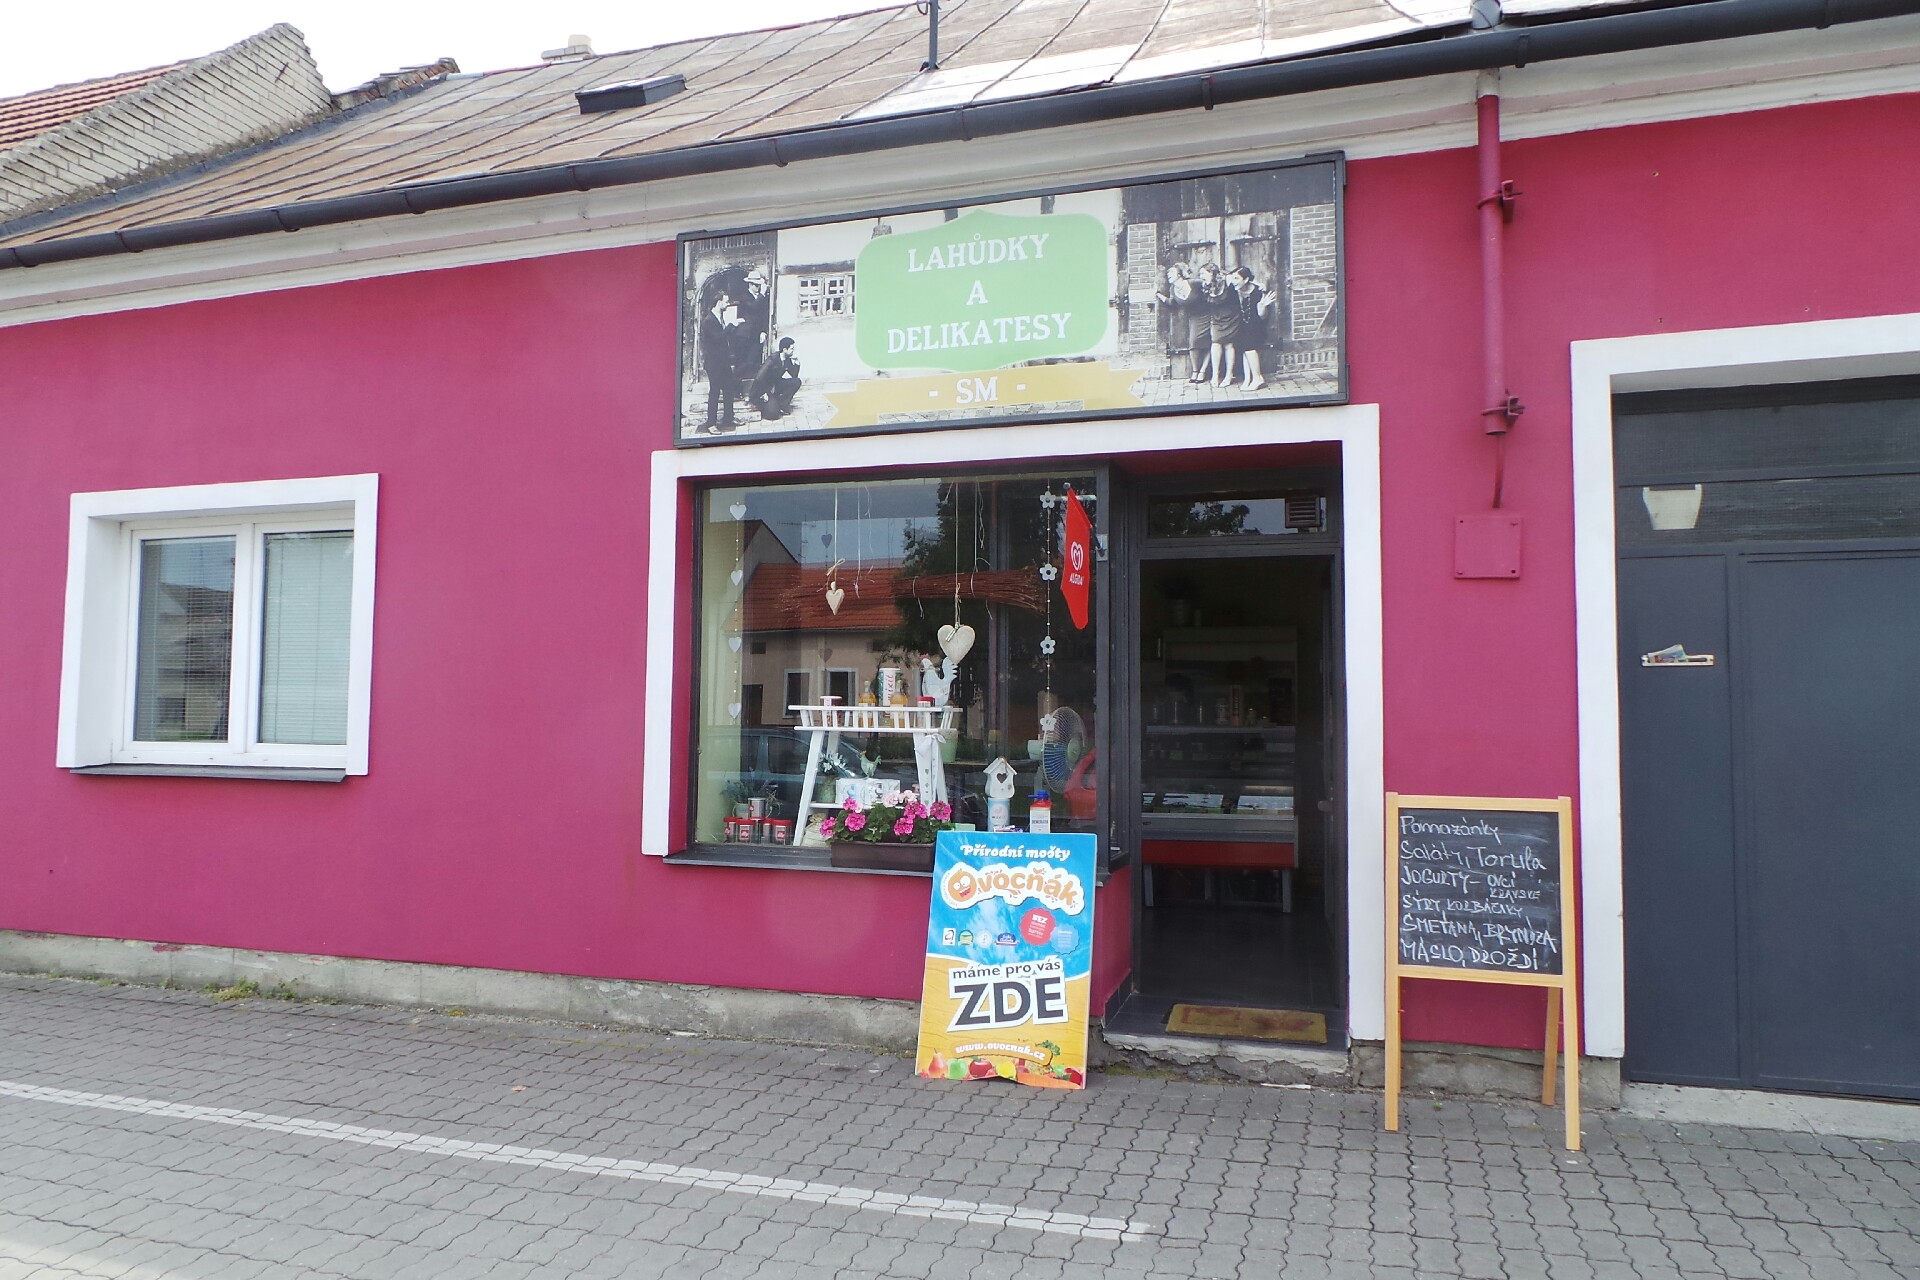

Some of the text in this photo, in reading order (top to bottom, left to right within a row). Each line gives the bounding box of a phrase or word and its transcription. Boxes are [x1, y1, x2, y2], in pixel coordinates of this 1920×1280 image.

[908, 233, 1049, 272] LAHŮDKY
[966, 280, 988, 305] A
[887, 312, 1072, 354] DELIKATESY
[956, 376, 998, 404] SM
[1400, 816, 1502, 845] Pomazánky
[960, 844, 1071, 861] Přírodní mošty
[952, 958, 1061, 979] máme pro vás
[954, 977, 1064, 1026] ZDE
[955, 1042, 1046, 1061] www.ovocnak.cz
